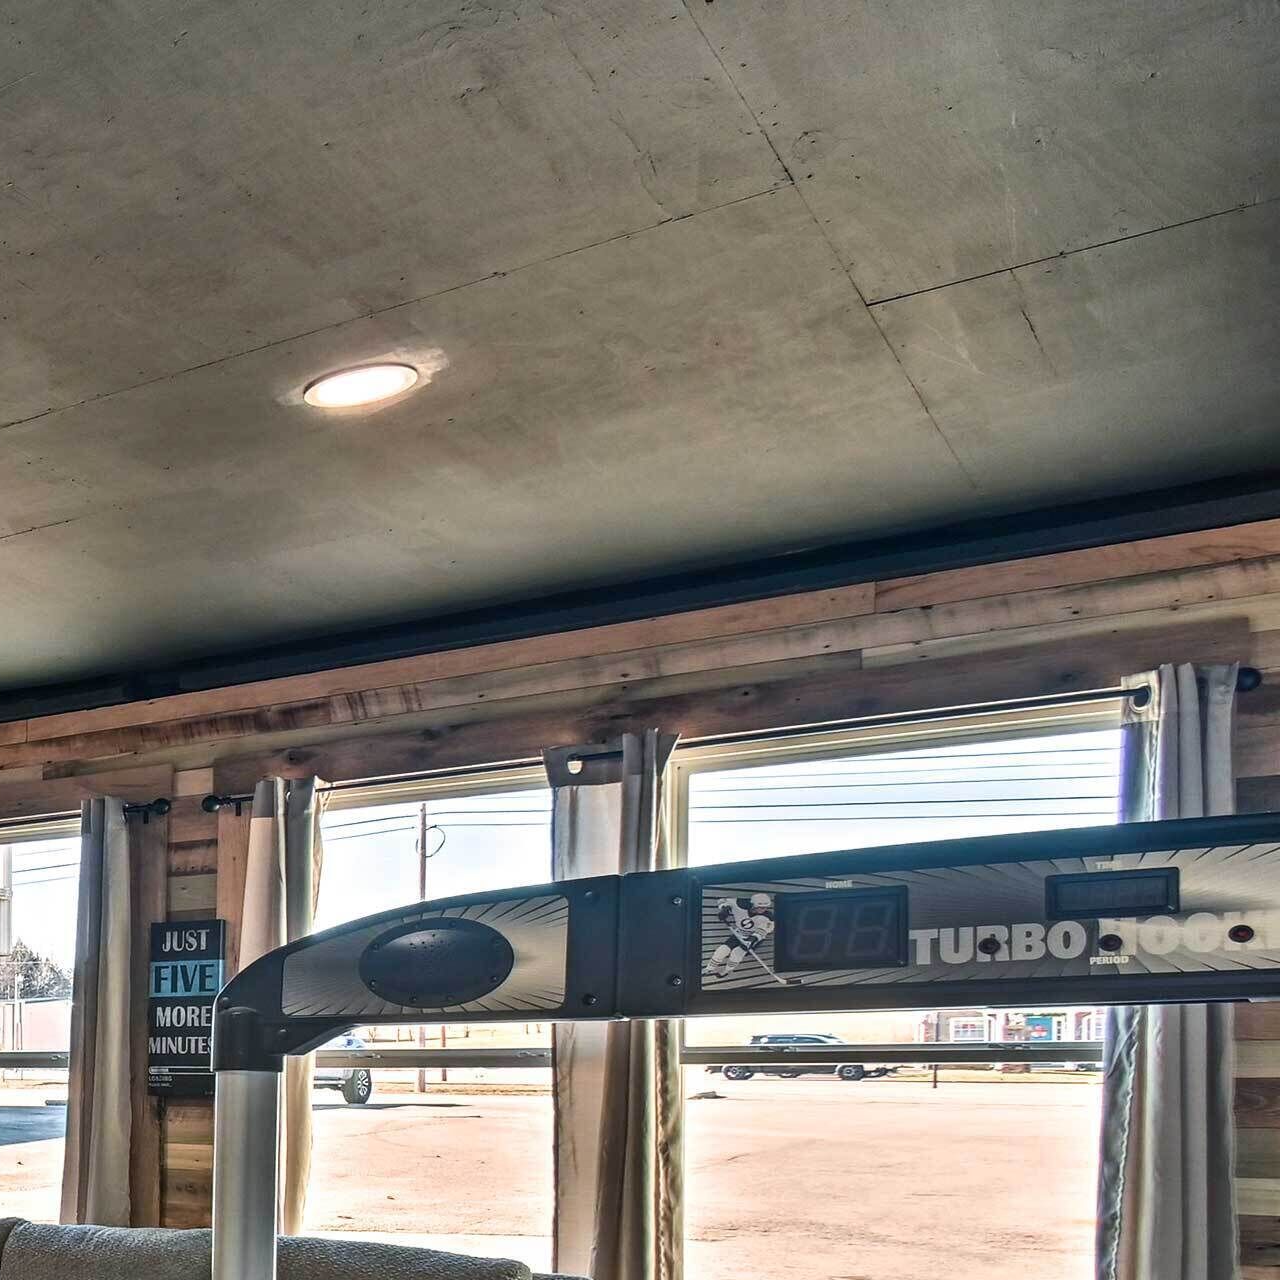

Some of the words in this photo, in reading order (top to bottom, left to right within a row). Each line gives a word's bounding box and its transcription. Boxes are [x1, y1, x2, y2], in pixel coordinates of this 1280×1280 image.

[825, 879, 853, 889] HOME
[162, 929, 210, 952] JUST
[908, 919, 1088, 966] TURBO
[1089, 954, 1130, 965] PERIOD
[154, 963, 215, 994] FIVE
[156, 1005, 212, 1028] MORE
